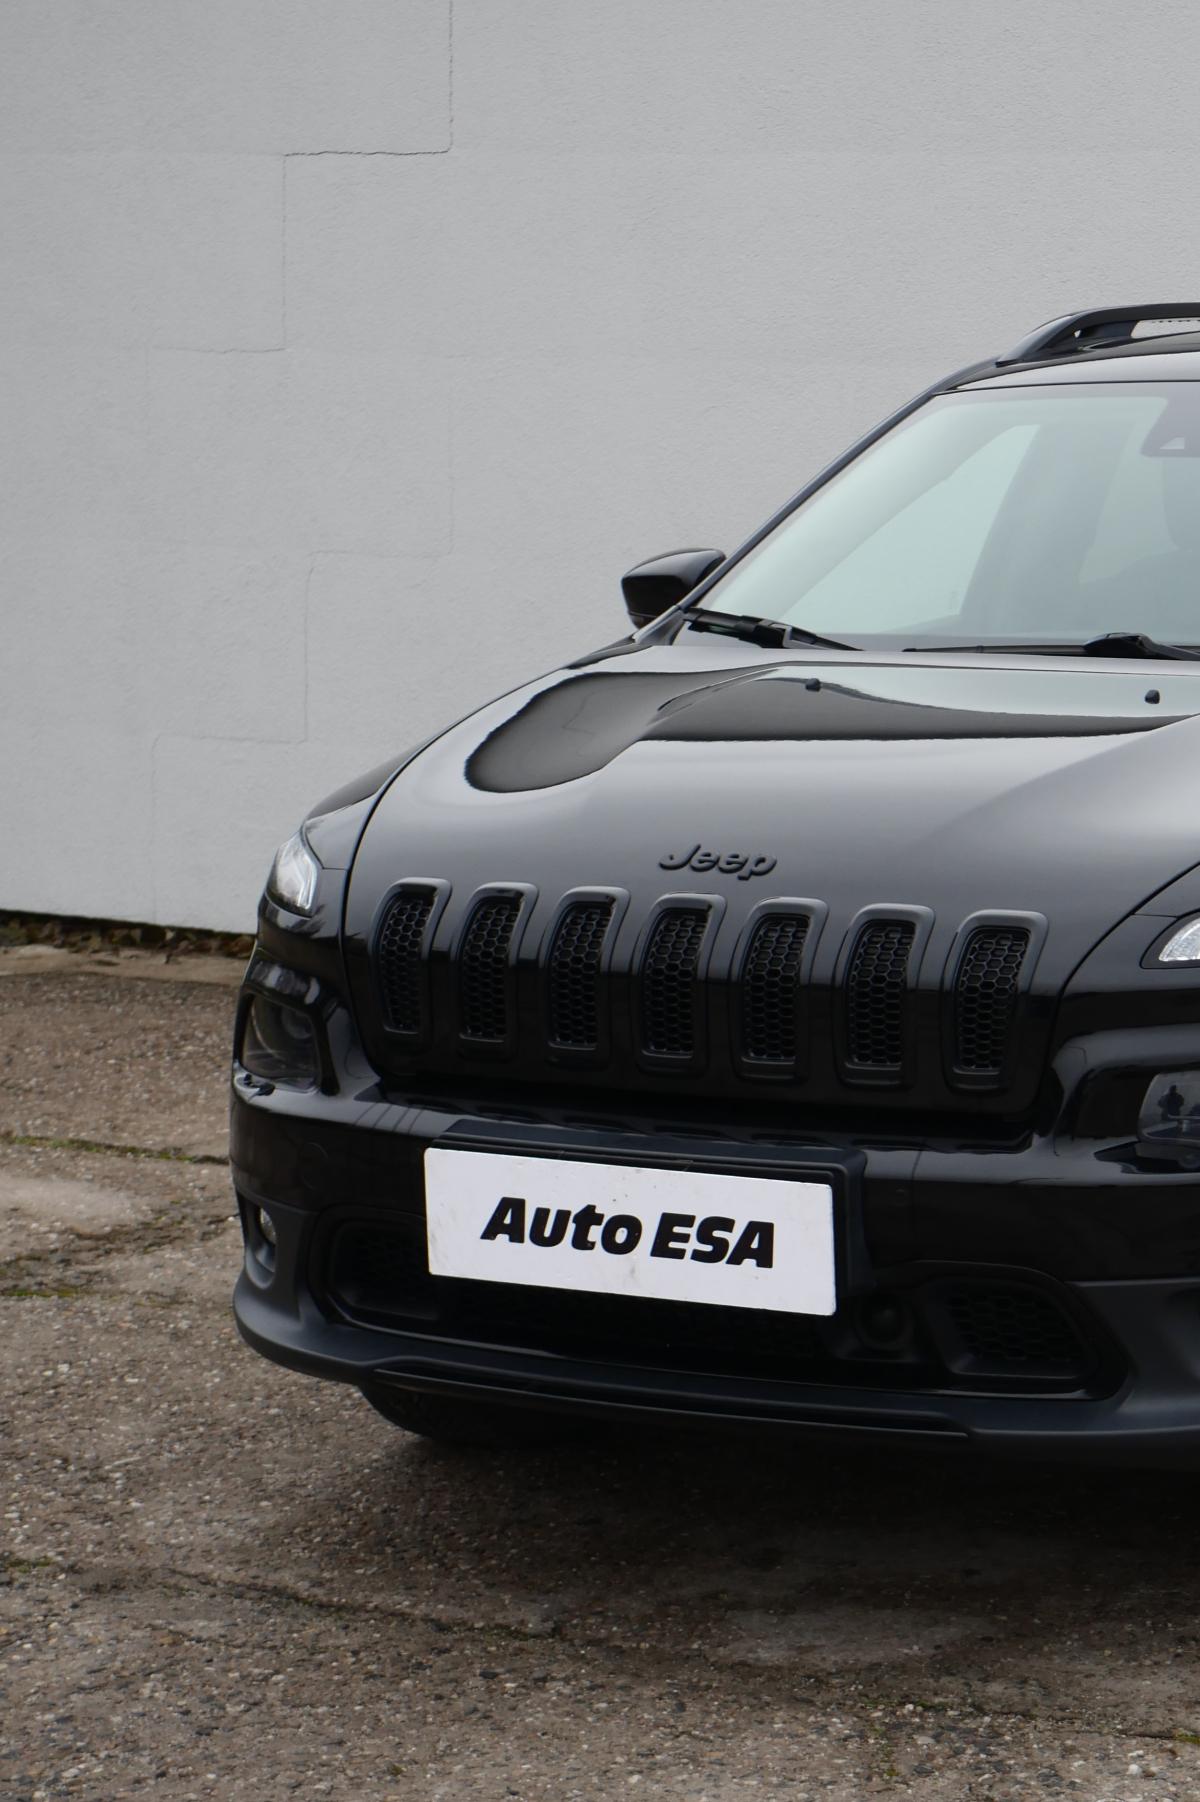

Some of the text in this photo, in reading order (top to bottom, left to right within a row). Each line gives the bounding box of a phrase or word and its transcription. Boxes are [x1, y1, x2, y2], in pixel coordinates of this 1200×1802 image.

[658, 843, 778, 881] Jeep
[480, 1196, 775, 1269] Auto ESA
